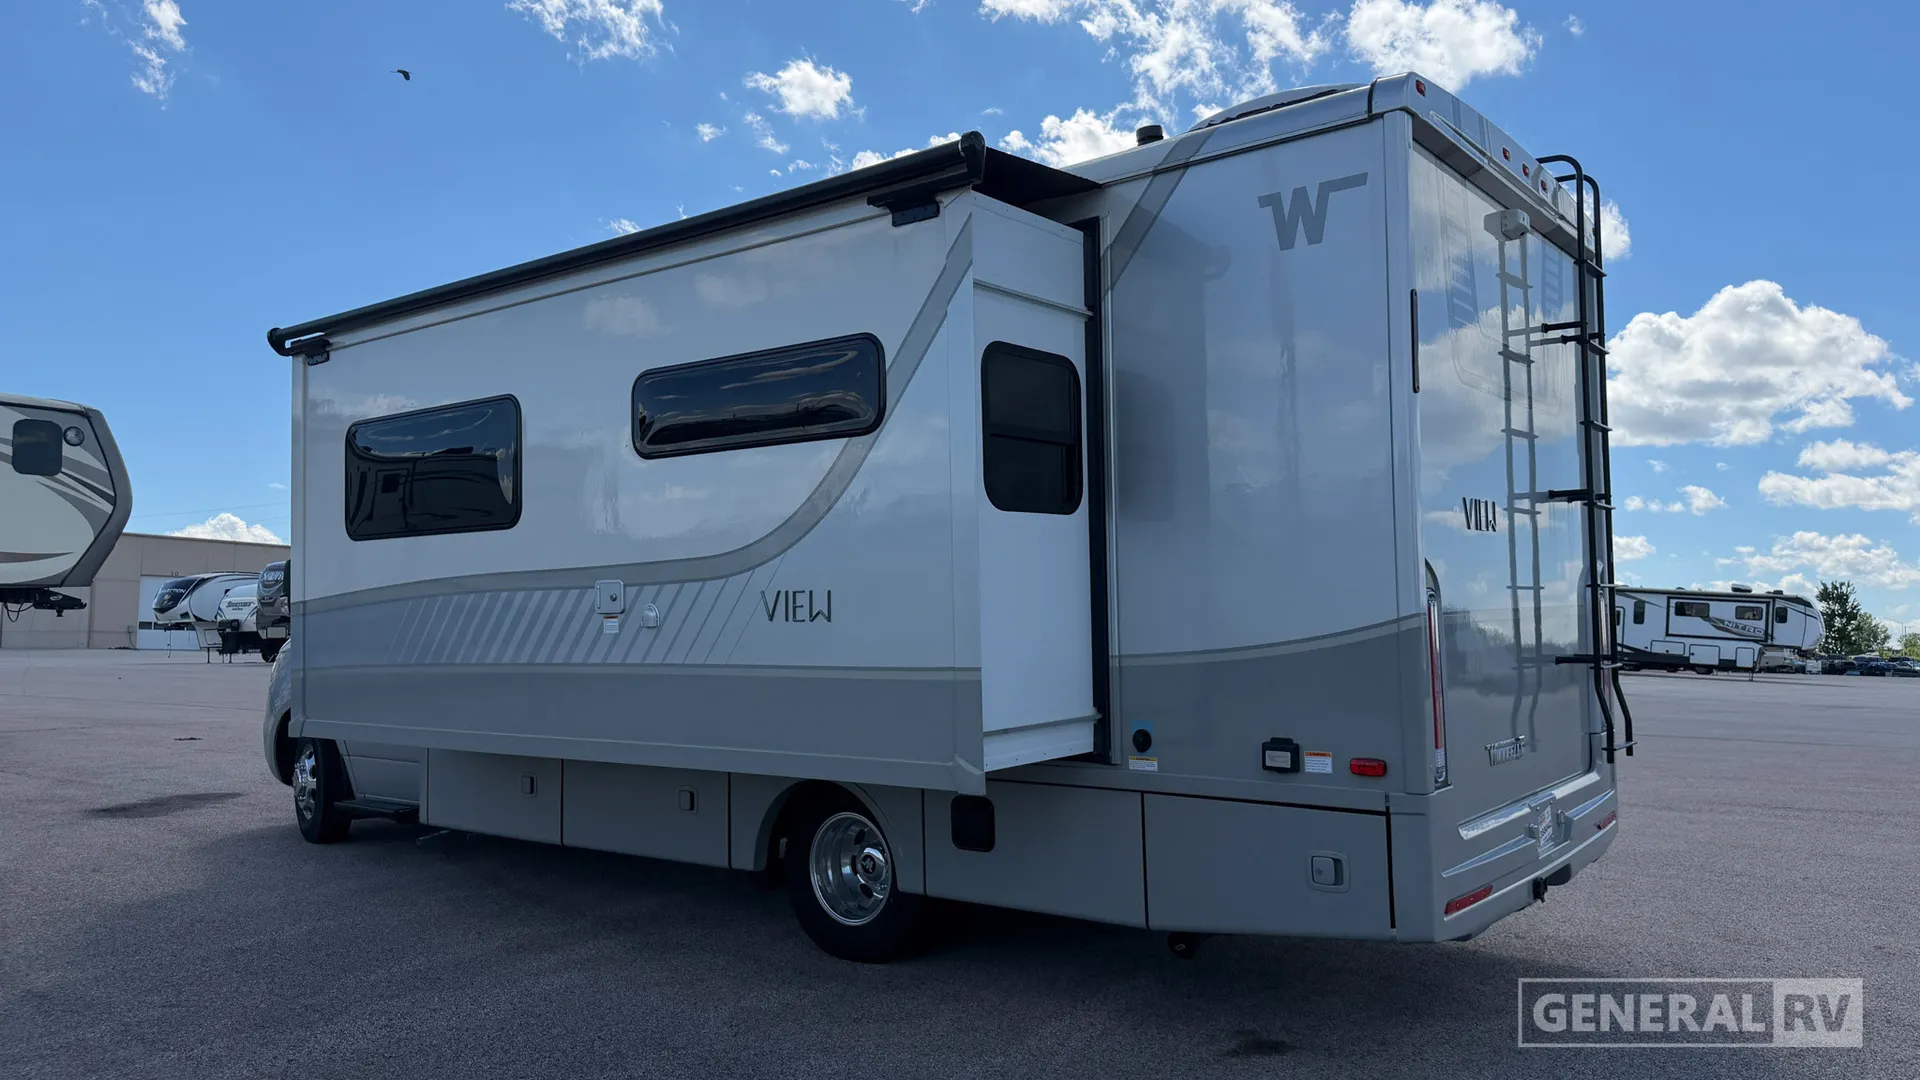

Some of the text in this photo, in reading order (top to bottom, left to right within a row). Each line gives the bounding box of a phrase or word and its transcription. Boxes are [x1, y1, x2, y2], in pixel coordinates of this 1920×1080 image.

[1462, 496, 1497, 532] VIEW
[760, 590, 832, 622] VIEW
[1724, 621, 1765, 635] NITRO
